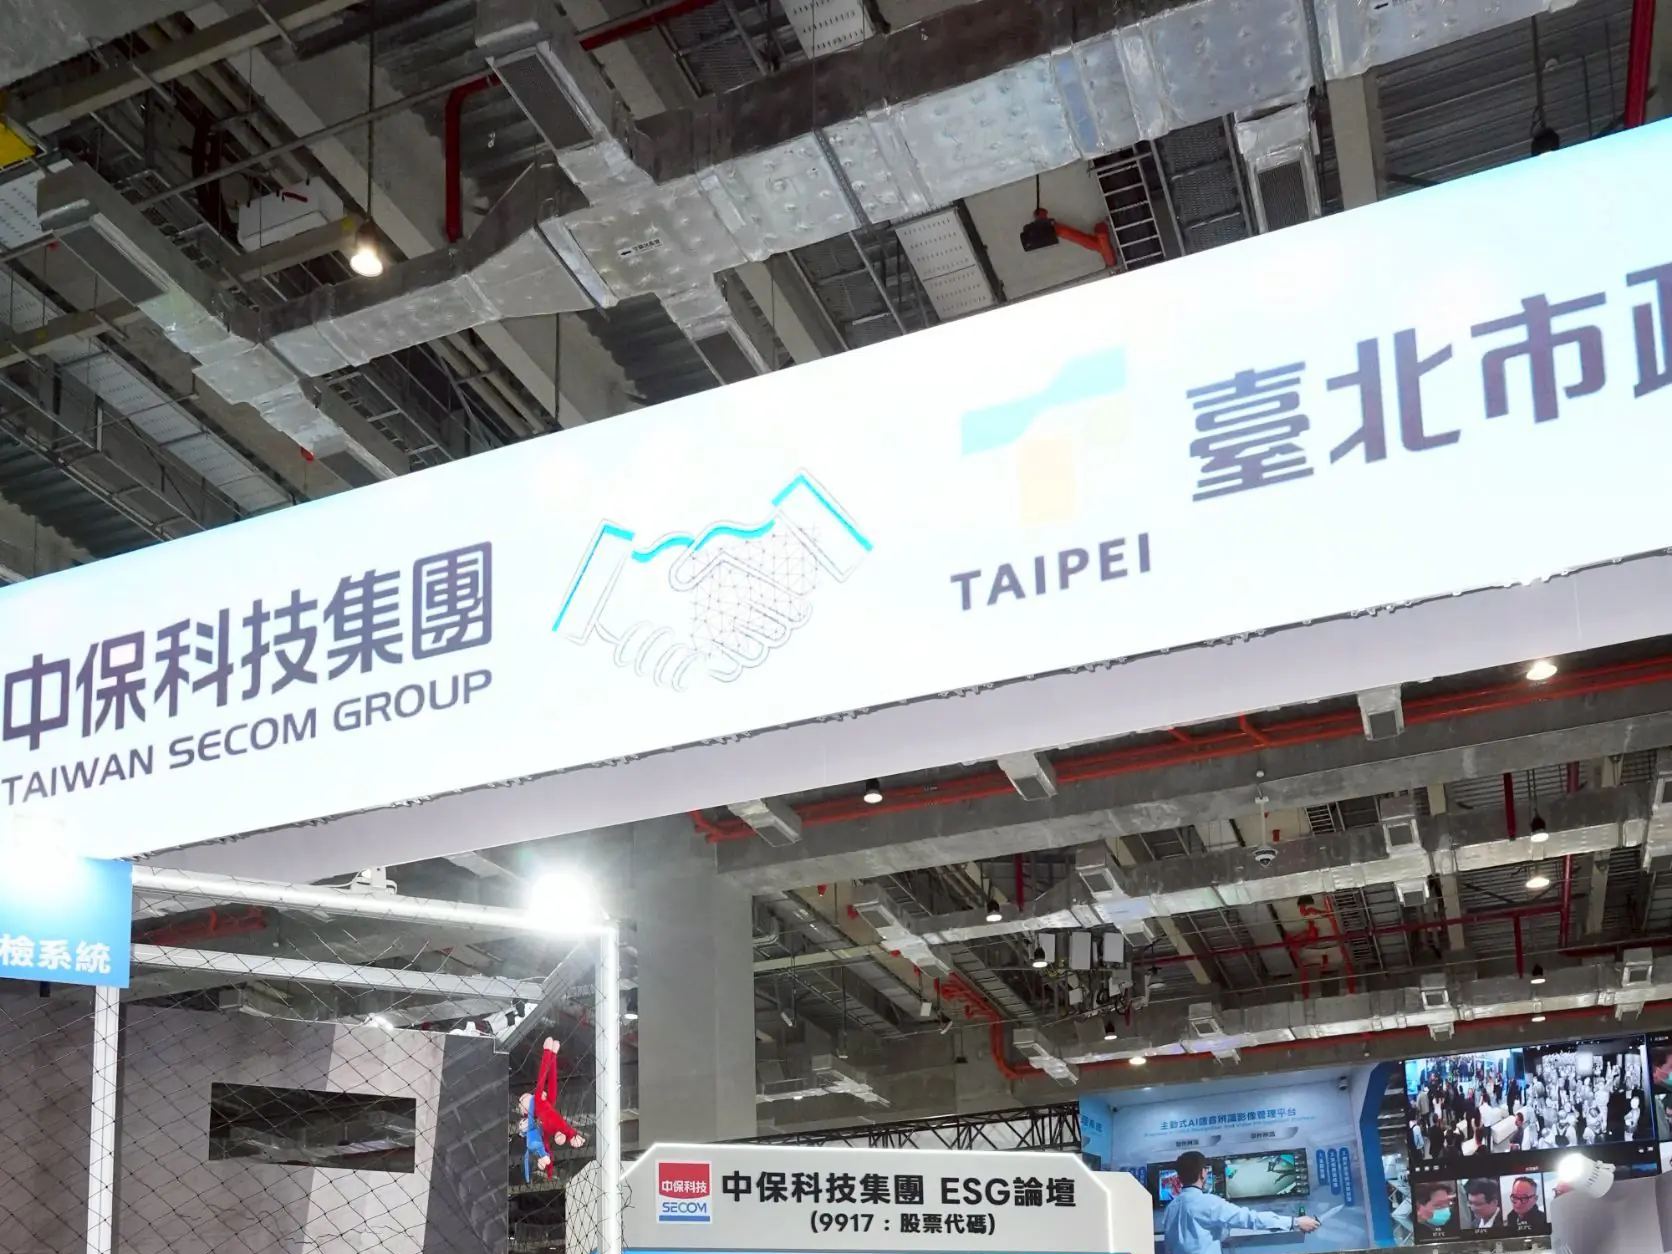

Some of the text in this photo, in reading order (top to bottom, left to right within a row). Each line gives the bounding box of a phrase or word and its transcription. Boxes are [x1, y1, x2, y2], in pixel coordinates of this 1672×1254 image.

[950, 533, 1152, 612] TAIPEI
[3, 541, 492, 751] 中保科技集團
[1, 669, 492, 806] TAIWAN SECOM GROUP
[0, 933, 111, 974] 檢系統
[661, 1180, 708, 1194] 中保科技
[722, 1171, 1076, 1207] 中保科技集團 ESG論壇
[661, 1202, 707, 1214] SECOM
